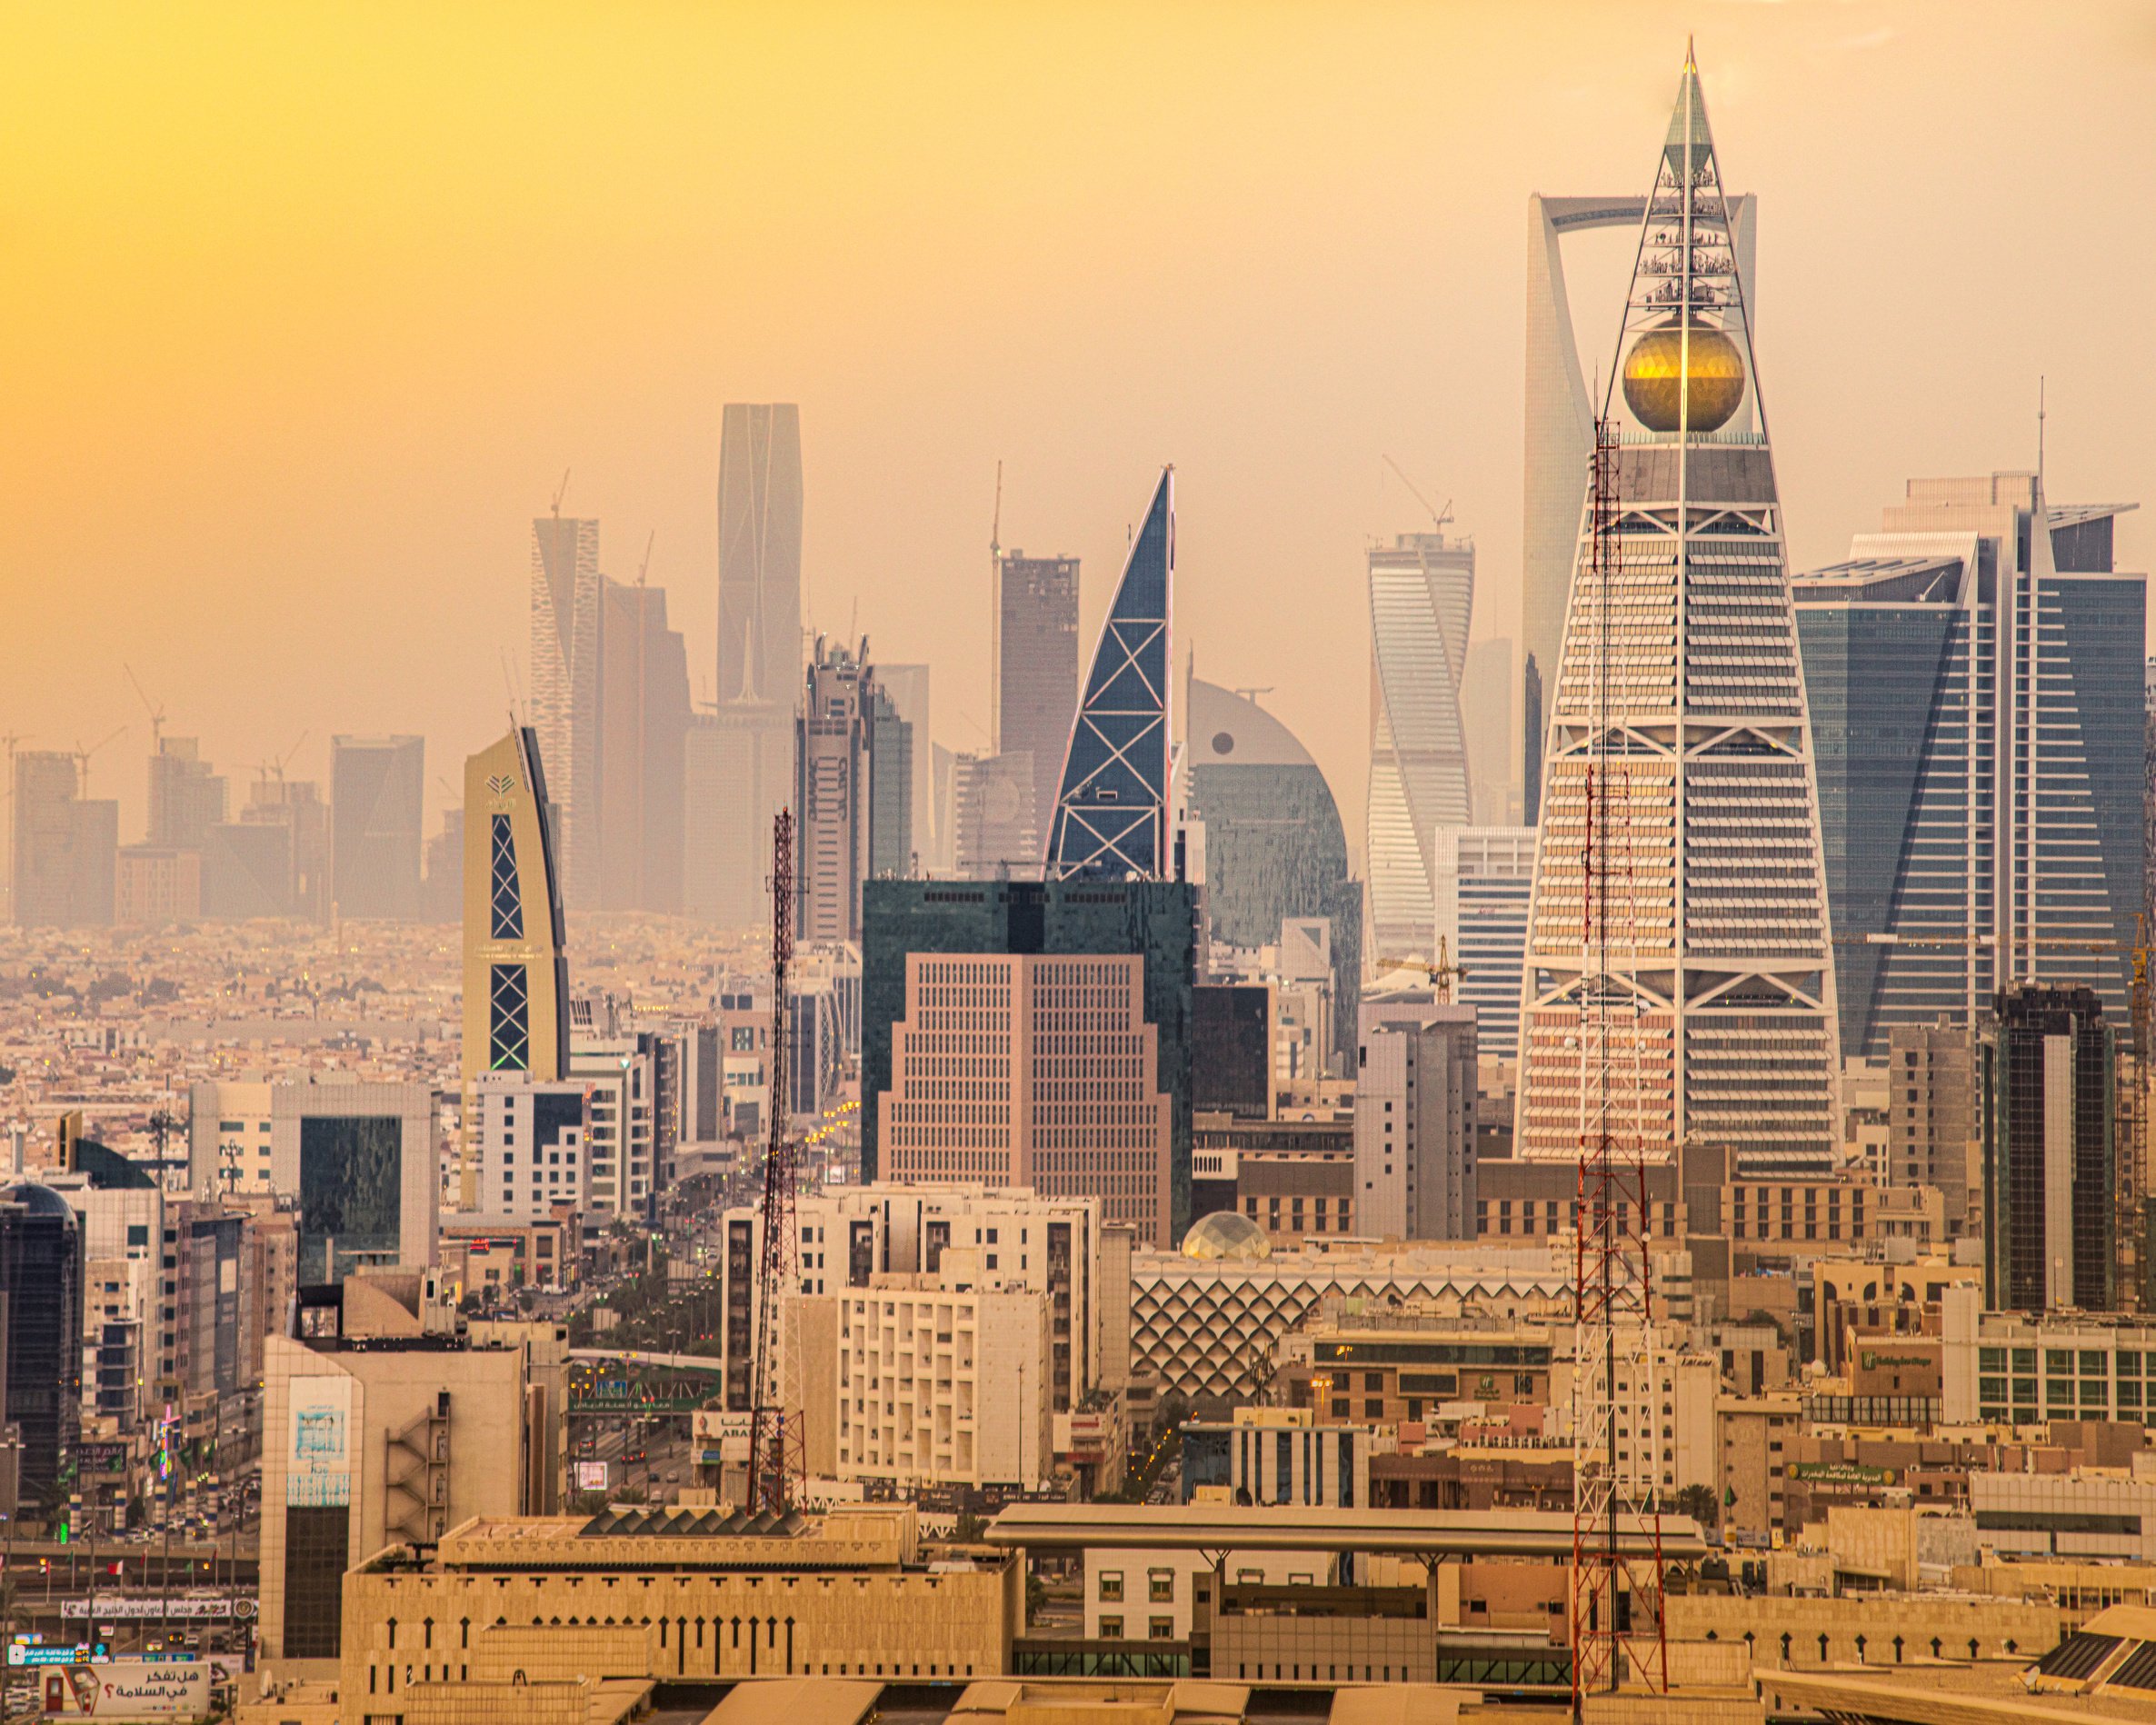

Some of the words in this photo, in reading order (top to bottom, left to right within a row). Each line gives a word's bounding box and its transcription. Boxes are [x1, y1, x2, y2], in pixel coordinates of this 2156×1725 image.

[145, 1670, 176, 1684] تفكر
[176, 1670, 199, 1684] هل
[115, 1684, 165, 1699] السلامة
[165, 1685, 187, 1702] في
